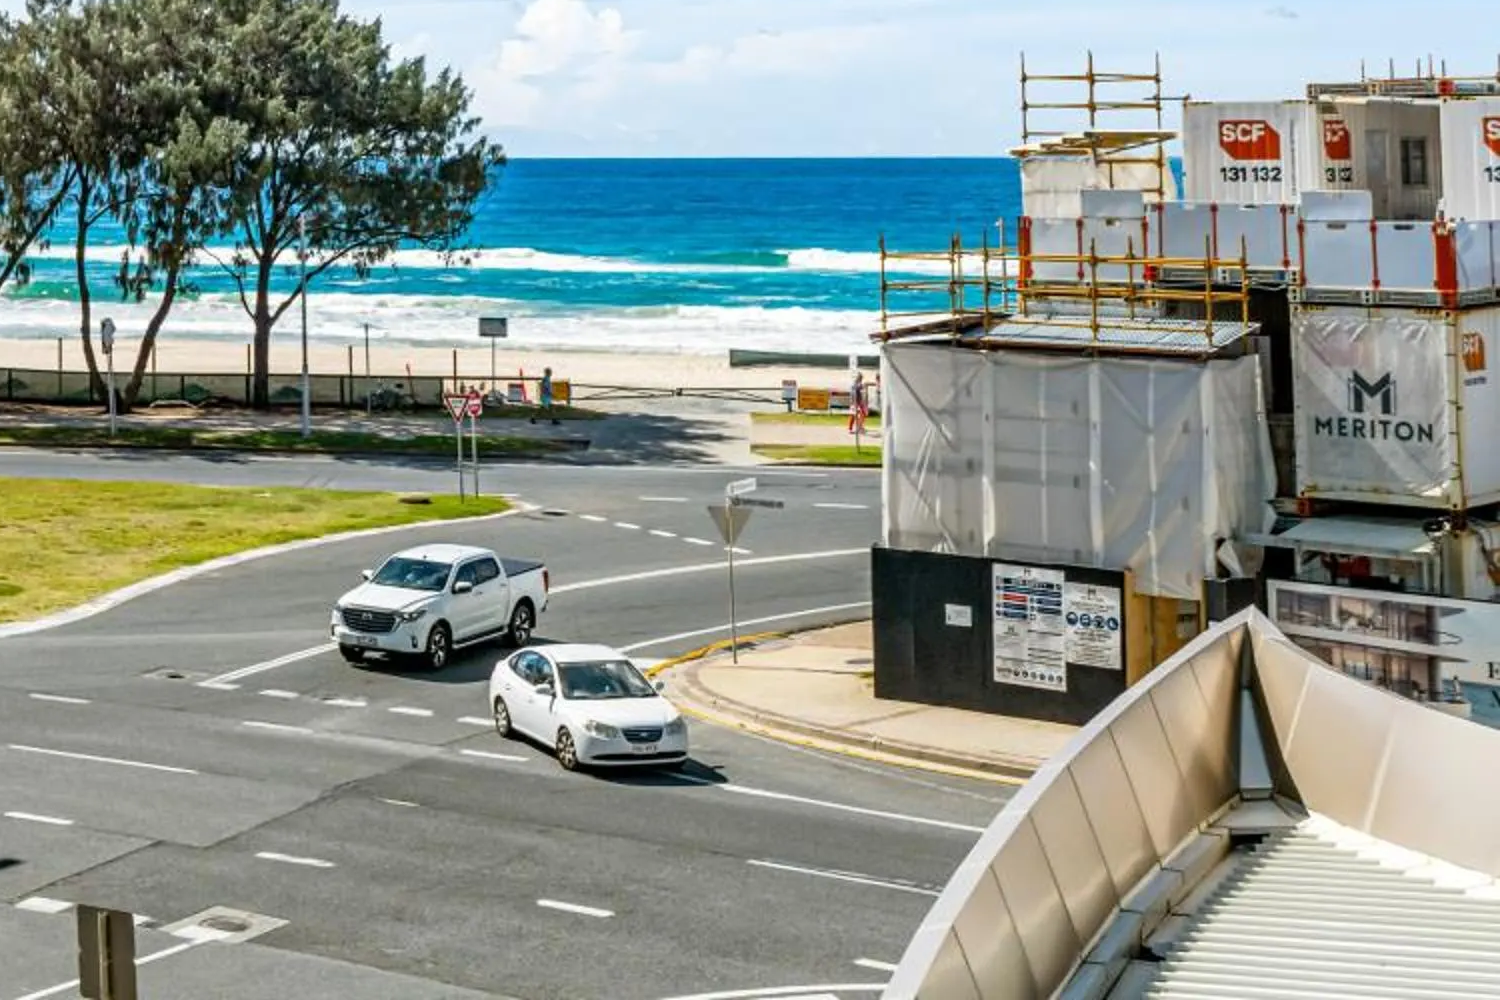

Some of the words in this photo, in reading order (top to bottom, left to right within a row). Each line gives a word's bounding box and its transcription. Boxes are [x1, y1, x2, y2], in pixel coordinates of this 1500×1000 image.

[1221, 123, 1265, 142] SCF
[1220, 166, 1248, 182] 131
[1251, 166, 1282, 182] 132
[1315, 416, 1433, 443] MERITON
